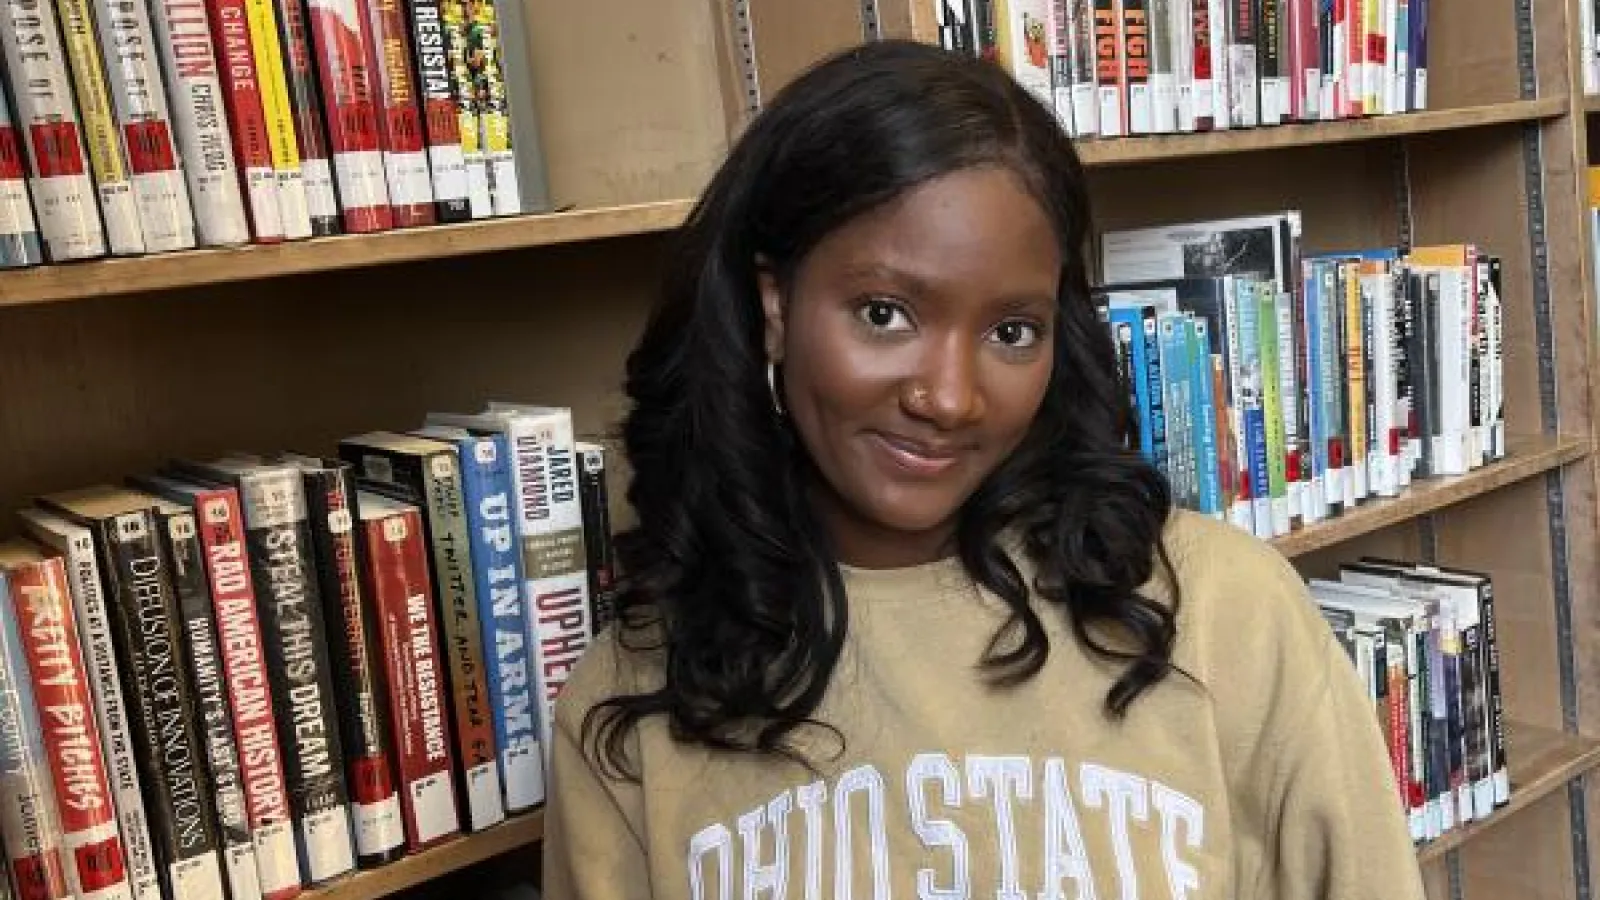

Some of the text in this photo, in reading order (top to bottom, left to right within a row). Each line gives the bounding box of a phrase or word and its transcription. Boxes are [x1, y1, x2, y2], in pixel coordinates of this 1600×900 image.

[221, 6, 254, 91] CHANGE
[517, 436, 550, 520] DIAMOND
[546, 444, 574, 504] JARED
[480, 492, 512, 552] UP
[266, 529, 304, 616] STEAL
[440, 532, 467, 622] TWITTER
[456, 635, 474, 675] AND
[488, 564, 521, 617] IN
[210, 540, 290, 822] RAD AMERICAN HISTORY
[280, 614, 316, 679] THIS
[408, 593, 446, 762] WE THE RESISTANCE
[130, 556, 208, 848] DIFFUSION OF INNOVATIONS
[290, 682, 332, 778] DREAM
[45, 705, 104, 811] BITCHES
[688, 752, 1203, 900] OHIO STATE
